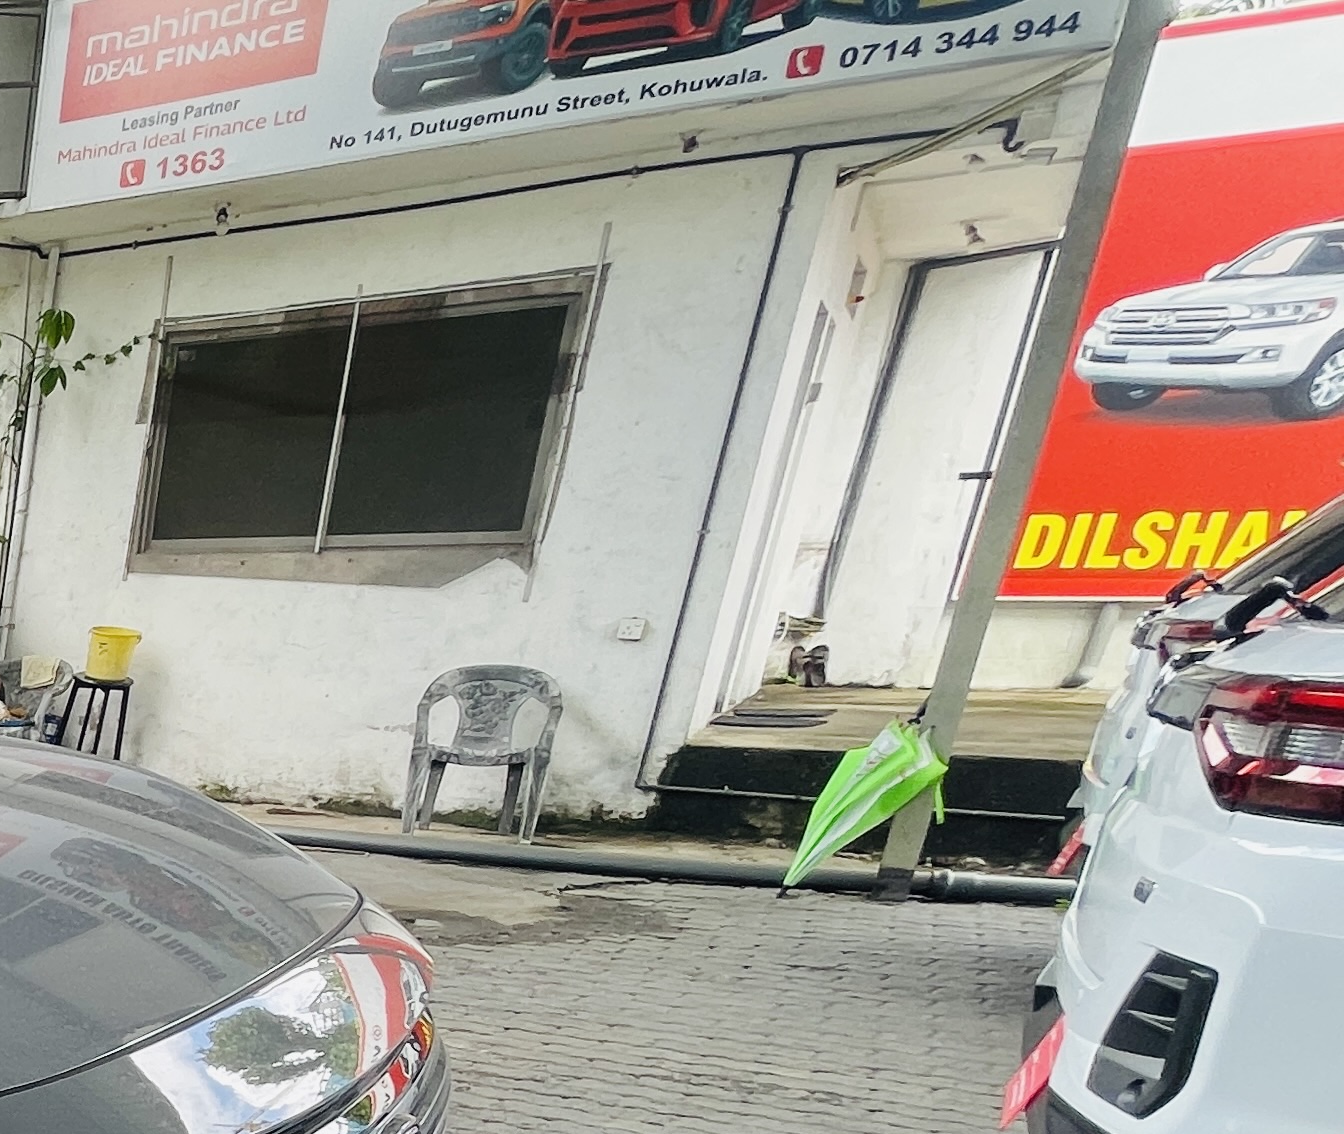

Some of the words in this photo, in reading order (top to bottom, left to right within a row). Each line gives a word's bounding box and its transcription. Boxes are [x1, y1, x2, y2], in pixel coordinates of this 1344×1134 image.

[82, 54, 149, 87] IDEAL
[155, 19, 306, 72] FINANCE
[86, 0, 298, 58] mahindra
[838, 36, 923, 69] 0714
[934, 24, 1000, 54] 344
[1013, 11, 1082, 42] 944
[57, 140, 137, 165] Mahindra
[143, 124, 186, 150] Ideal
[192, 115, 267, 142] Finance
[273, 105, 308, 127] Ltd
[121, 109, 179, 132] Leasing
[184, 99, 241, 121] Partner
[329, 134, 356, 150] No
[363, 125, 403, 144] 141,
[409, 102, 550, 138] Dutugemunu
[556, 89, 631, 113] Street,
[639, 68, 769, 101] Kohuwala.
[156, 147, 226, 180] 1363
